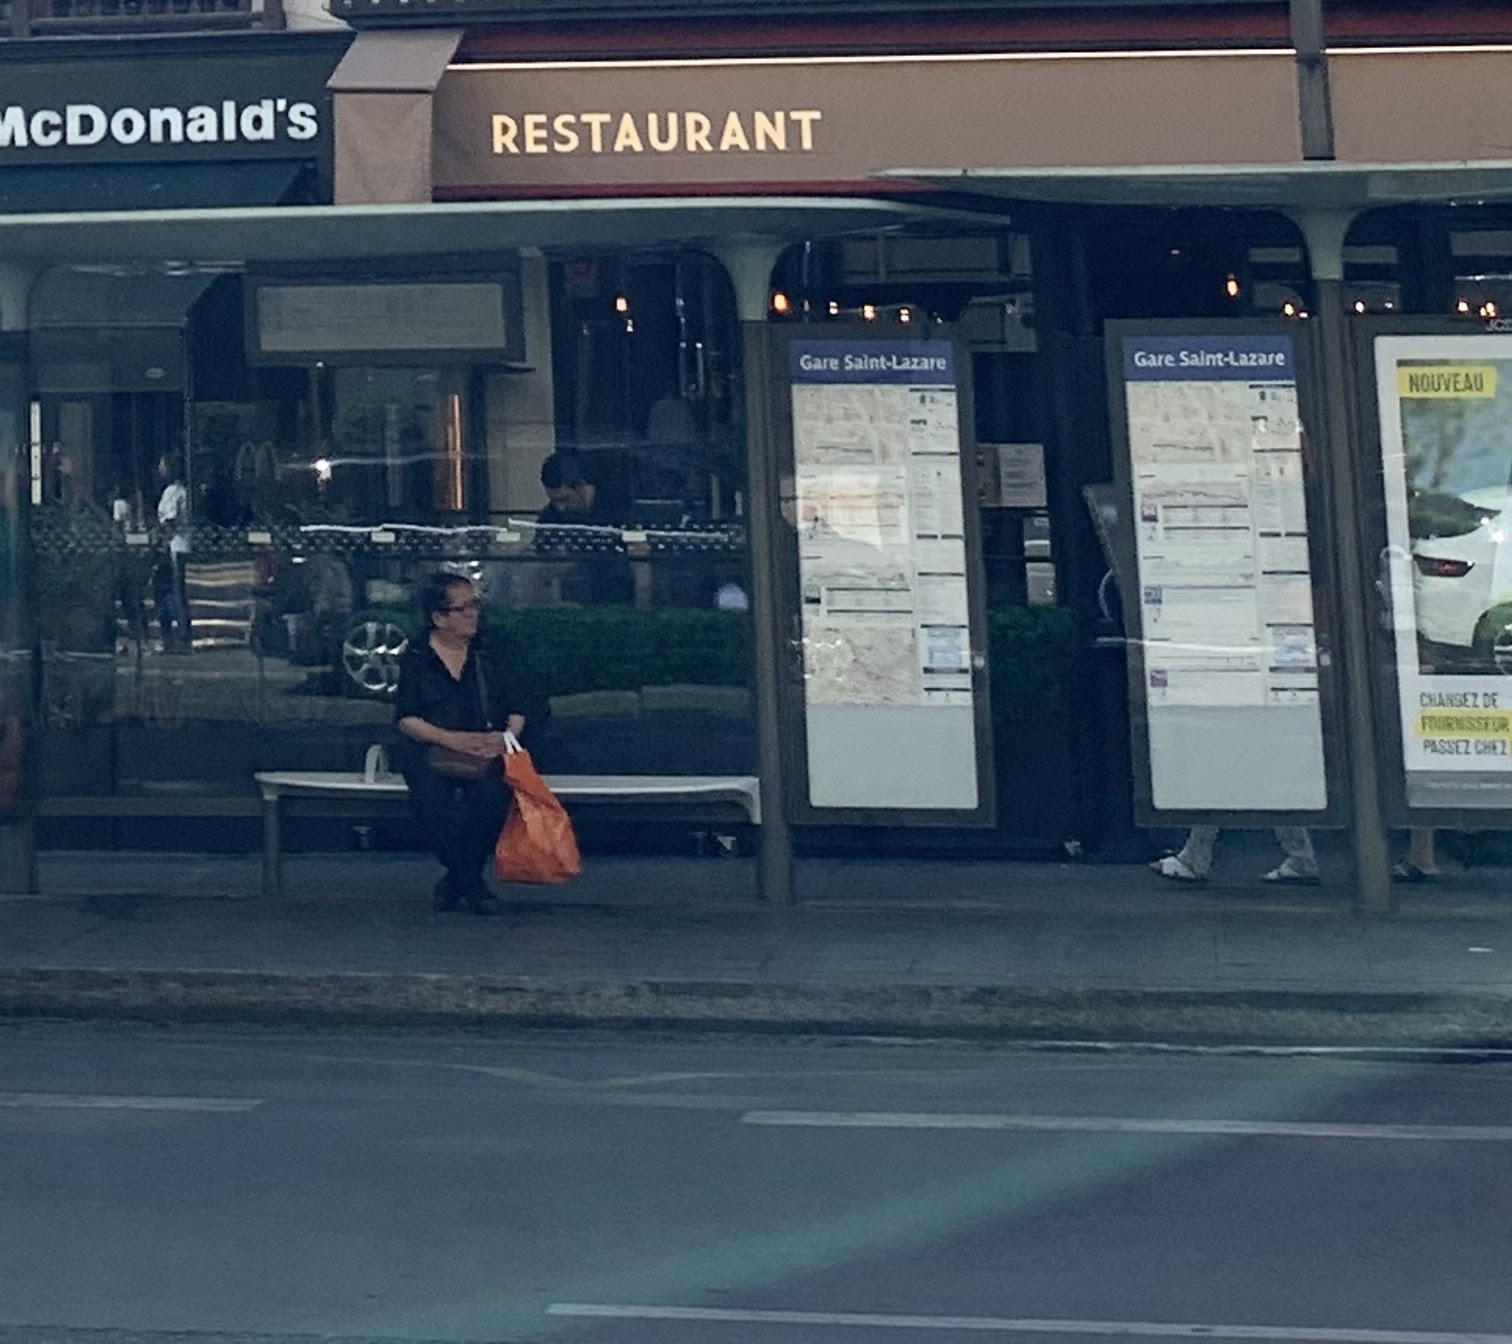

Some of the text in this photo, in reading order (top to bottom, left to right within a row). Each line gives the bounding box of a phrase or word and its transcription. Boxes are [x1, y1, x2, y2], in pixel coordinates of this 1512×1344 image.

[492, 110, 821, 155] RESTAURANT
[800, 353, 947, 371] Gare Saint-Lazare
[1134, 350, 1285, 367] Gare Saint-Lazare
[1408, 372, 1484, 393] NOUVEAU
